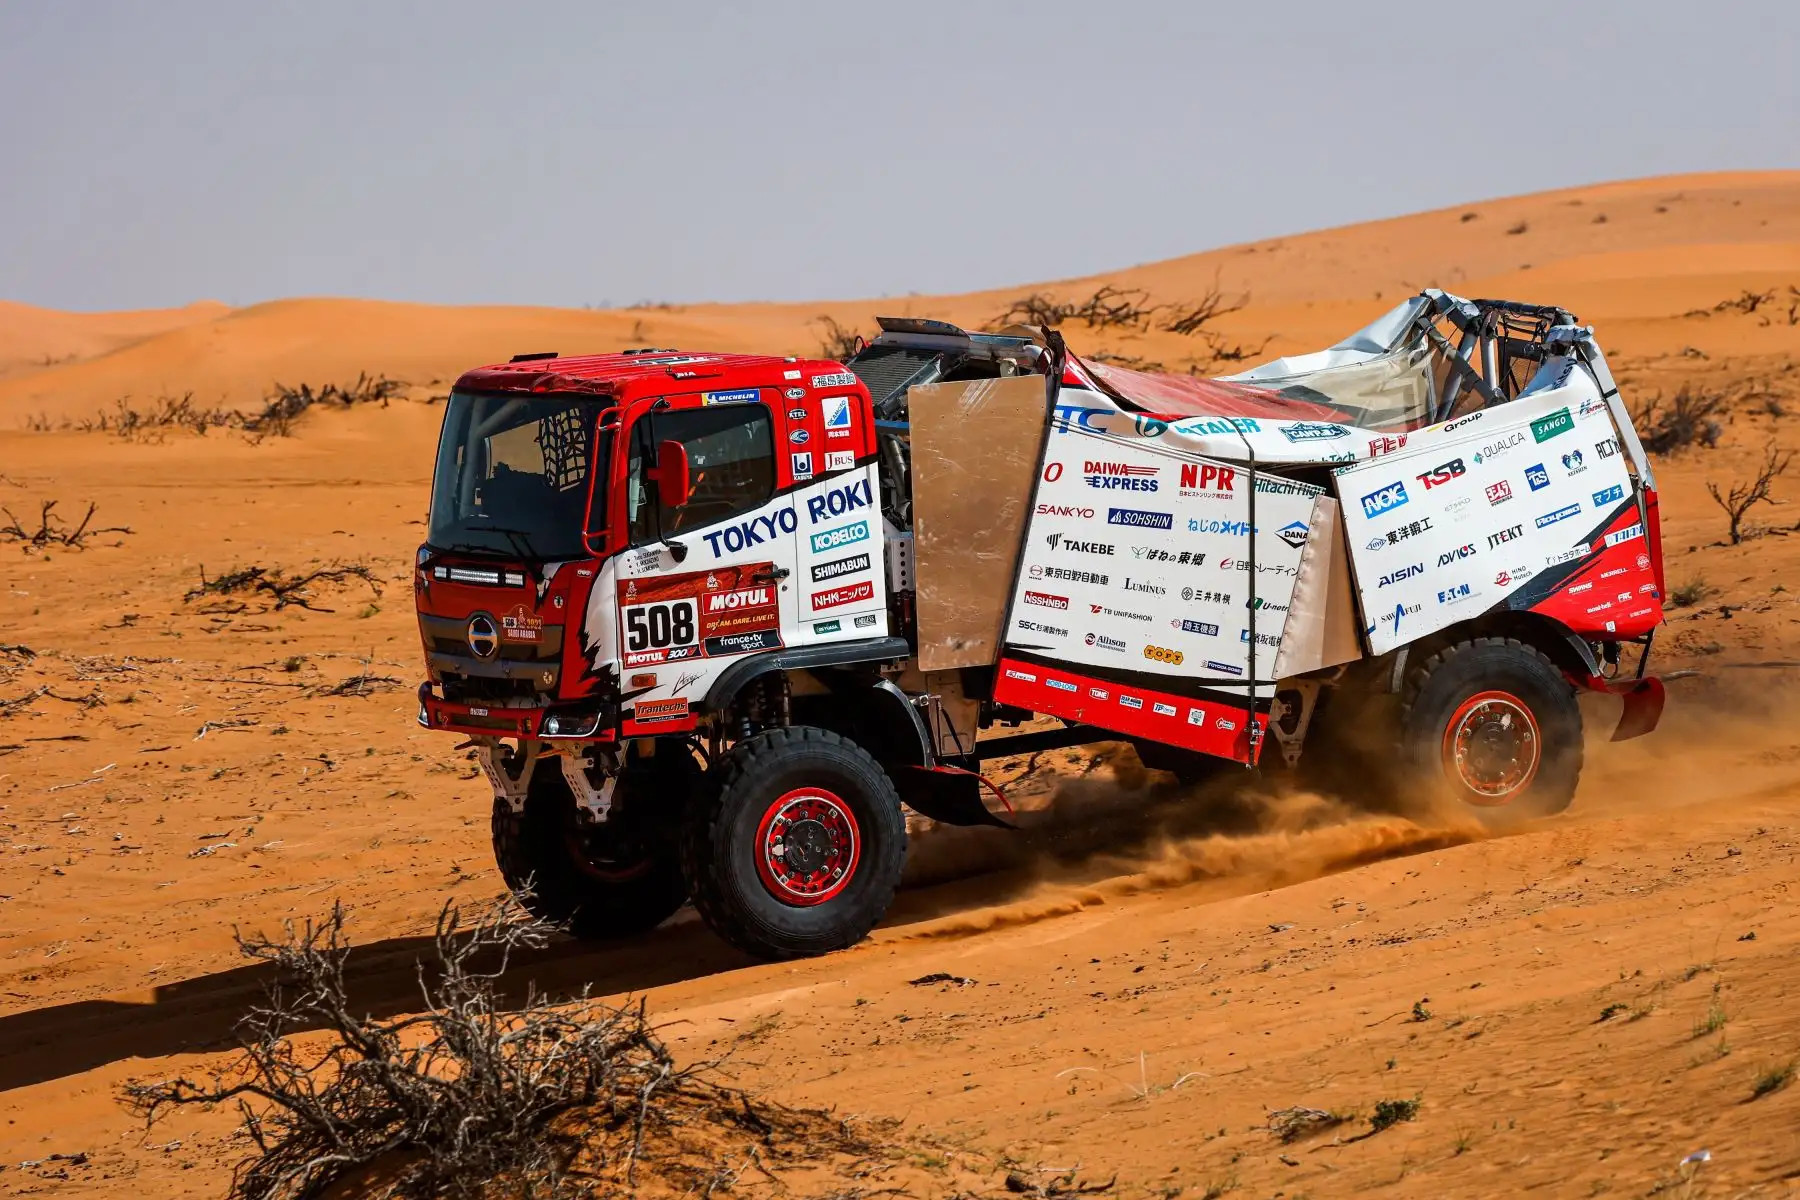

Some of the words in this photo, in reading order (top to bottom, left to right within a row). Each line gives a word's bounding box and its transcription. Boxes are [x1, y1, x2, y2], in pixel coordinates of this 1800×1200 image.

[718, 393, 755, 402] MICHELIN
[827, 399, 846, 427] OKAMOTO
[1444, 412, 1483, 433] Group
[1538, 417, 1566, 435] SANGO
[1483, 432, 1526, 458] QUALICA
[1084, 461, 1129, 476] DAIWA
[1416, 458, 1467, 490] TSB
[1092, 476, 1159, 492] EXPRESS
[1179, 463, 1236, 492] NPR
[1363, 484, 1405, 515] NOK
[1594, 487, 1621, 504] マブチ
[703, 506, 798, 559] TOKYO
[806, 478, 874, 524] ROKI
[1036, 504, 1095, 519] SANKYO
[1123, 512, 1170, 527] SOHSHIN
[813, 523, 866, 550] KOBELCO
[1284, 530, 1308, 540] DANA
[1487, 524, 1524, 551] JTEKT
[1064, 540, 1114, 556] TAKEBE
[1437, 543, 1477, 568] ADVICS
[1147, 548, 1206, 566] ばねの東郷
[814, 556, 869, 580] SHIMABUN
[1044, 566, 1109, 586] 東京日野自動車
[1378, 562, 1424, 588] AISIN
[1511, 565, 1527, 575] HINO
[709, 588, 769, 611] MOTUL
[732, 617, 751, 626] DARE.
[752, 615, 765, 623] LIVE
[766, 613, 775, 621] IT.
[1103, 607, 1113, 616] TB
[1114, 609, 1153, 622] UNIFASHION
[627, 602, 695, 651] 508
[1018, 620, 1036, 631] SSC
[741, 641, 765, 651] sport
[1096, 634, 1127, 648] Allison
[627, 652, 664, 664] MOTUL
[1146, 648, 1181, 662] TOPY
[1091, 689, 1108, 699] TONE
